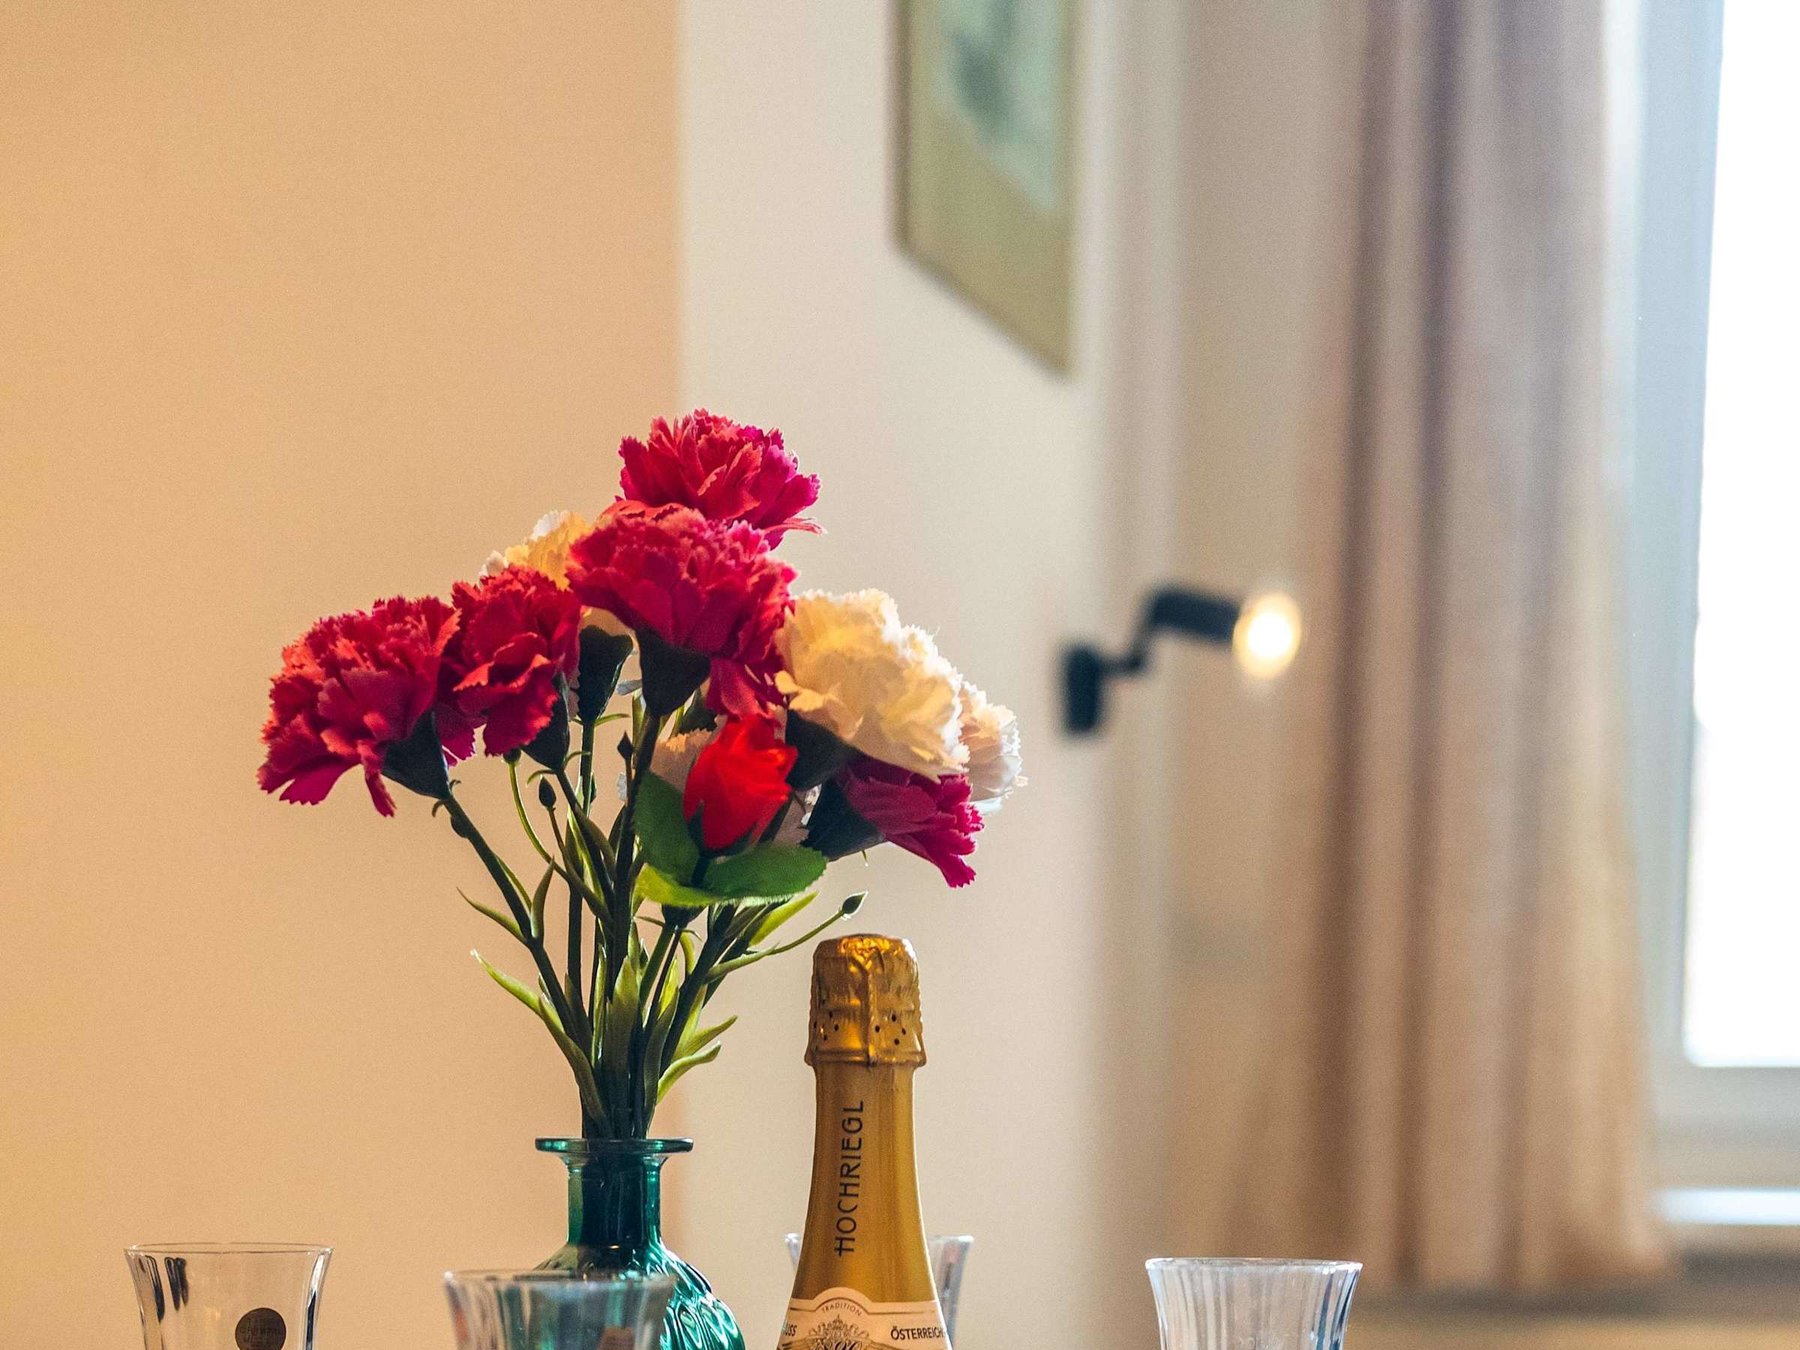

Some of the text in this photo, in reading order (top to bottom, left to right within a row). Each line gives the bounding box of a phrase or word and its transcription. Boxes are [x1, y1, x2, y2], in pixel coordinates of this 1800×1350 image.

[834, 1101, 864, 1257] HOCHRIEGL
[821, 1302, 862, 1316] TRADITION
[890, 1325, 945, 1341] ÖSTERREICH
